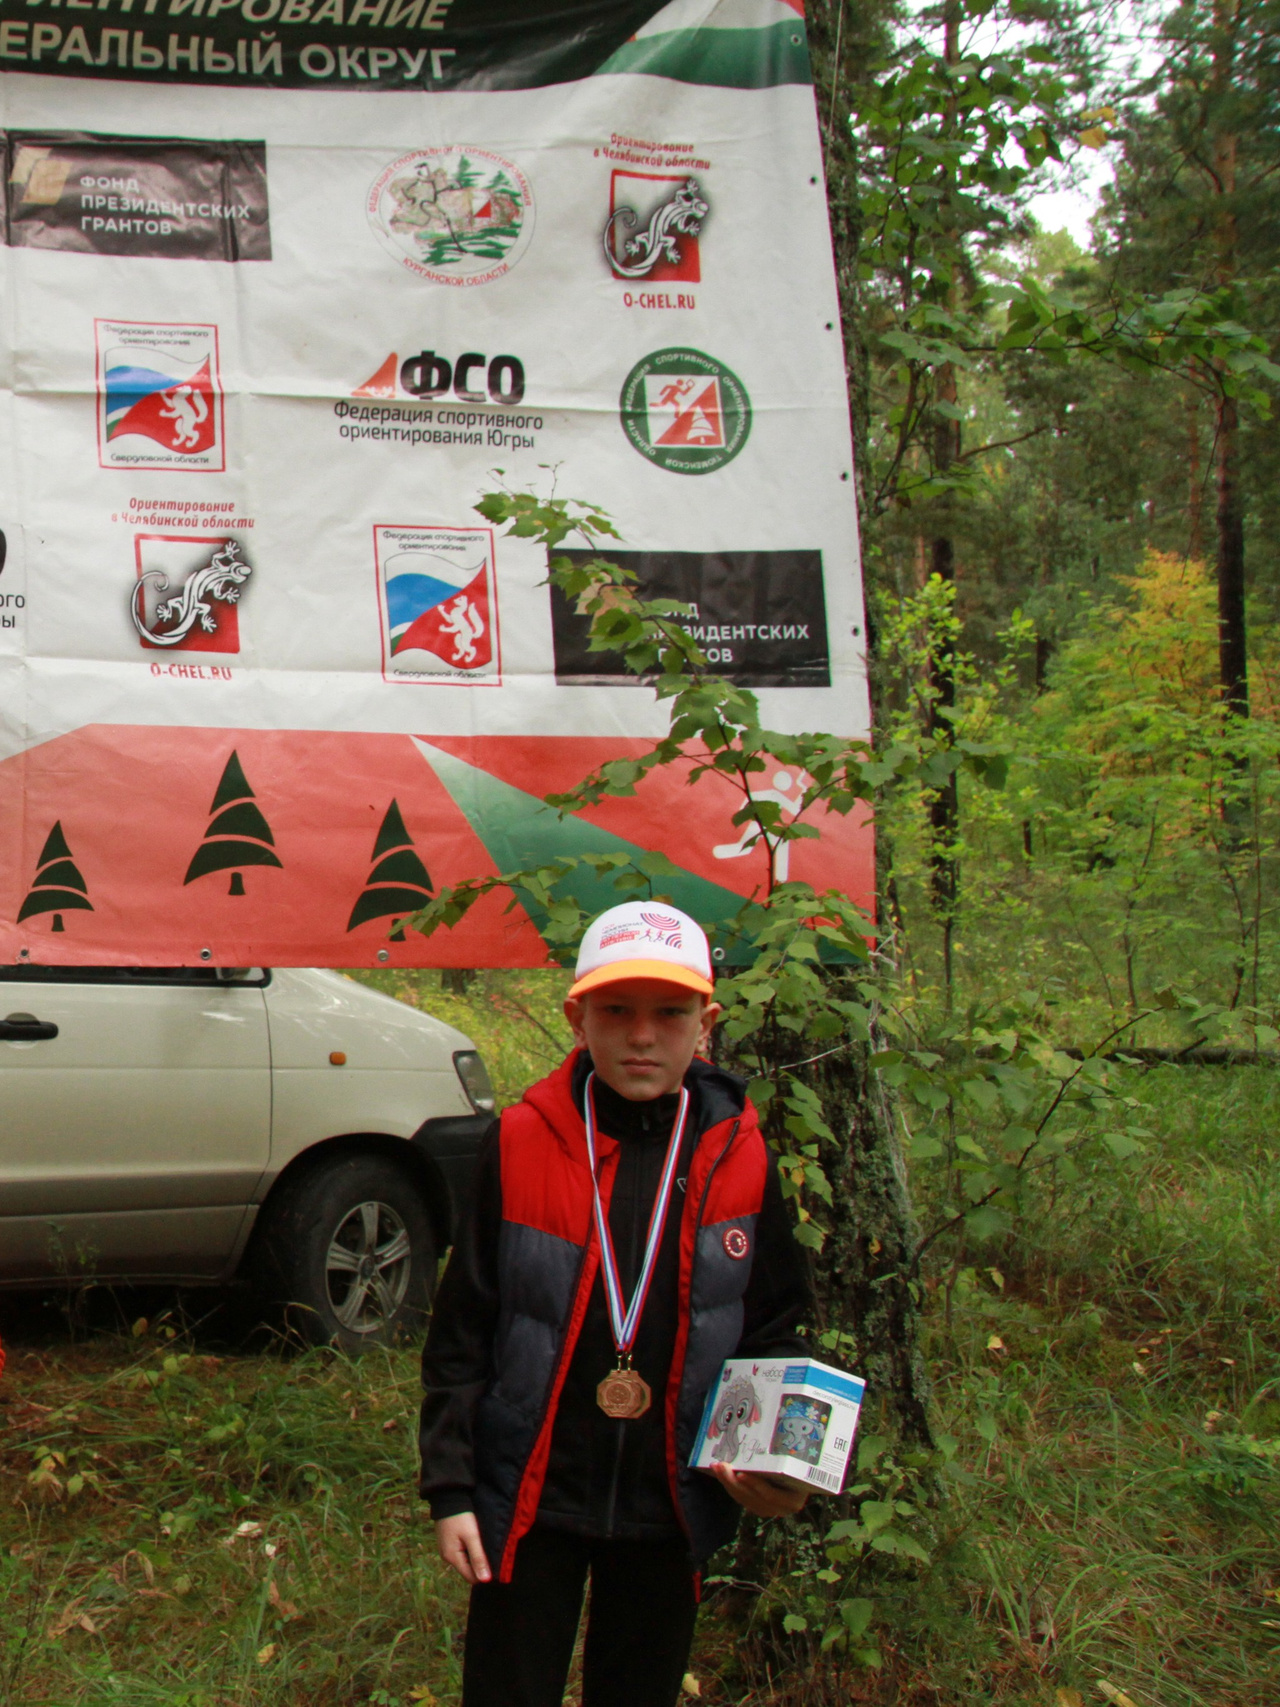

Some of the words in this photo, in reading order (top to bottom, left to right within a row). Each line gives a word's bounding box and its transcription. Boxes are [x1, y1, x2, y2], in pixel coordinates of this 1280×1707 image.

[299, 43, 456, 80] ОКРУГ
[610, 133, 694, 154] Ориентирование
[593, 148, 599, 158] в
[603, 147, 662, 167] Челябинской
[665, 155, 710, 170] области
[80, 175, 140, 193] ФОНД
[81, 194, 251, 220] ПРЕЗИДЕНТСКИХ
[81, 217, 172, 235] ГРАНТОВ
[623, 292, 695, 309] O-CHEL.RU
[655, 353, 719, 374] СПОРТИВНОГО
[400, 350, 525, 406] ФСО
[334, 400, 433, 424] Федерация
[437, 409, 543, 430] спортивного
[339, 425, 482, 446] ориентирования
[487, 428, 534, 451] Югры
[129, 497, 235, 513] Ориентирование
[111, 513, 117, 522] в
[122, 512, 198, 528] Челябинской
[202, 515, 255, 529] области
[647, 624, 809, 642] ЗИДЕНТСКИХ
[150, 662, 232, 681] O-CHEL.RU
